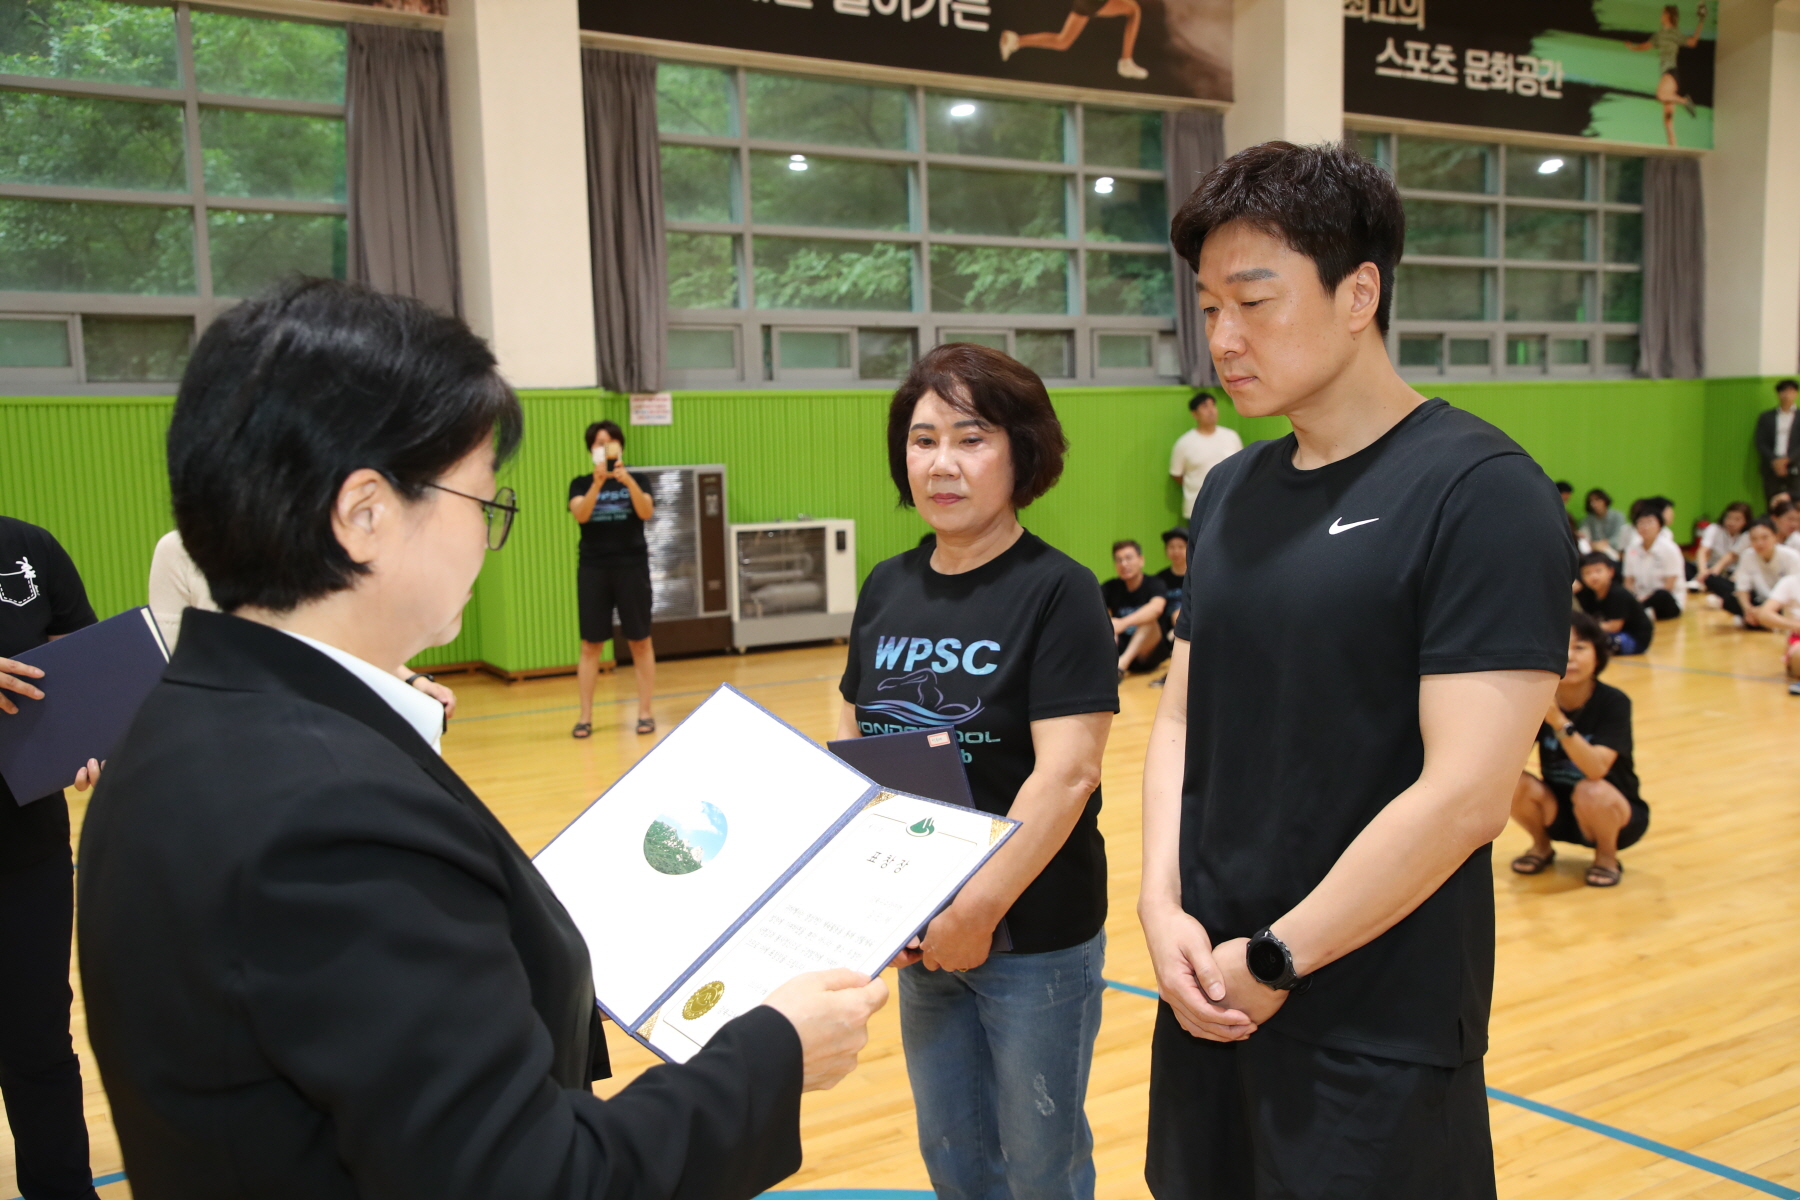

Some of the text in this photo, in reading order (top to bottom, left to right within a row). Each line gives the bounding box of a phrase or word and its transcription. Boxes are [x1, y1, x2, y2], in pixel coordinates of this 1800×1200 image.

[1375, 37, 1565, 99] 스포츠 문화공간
[874, 635, 1001, 675] WPSC
